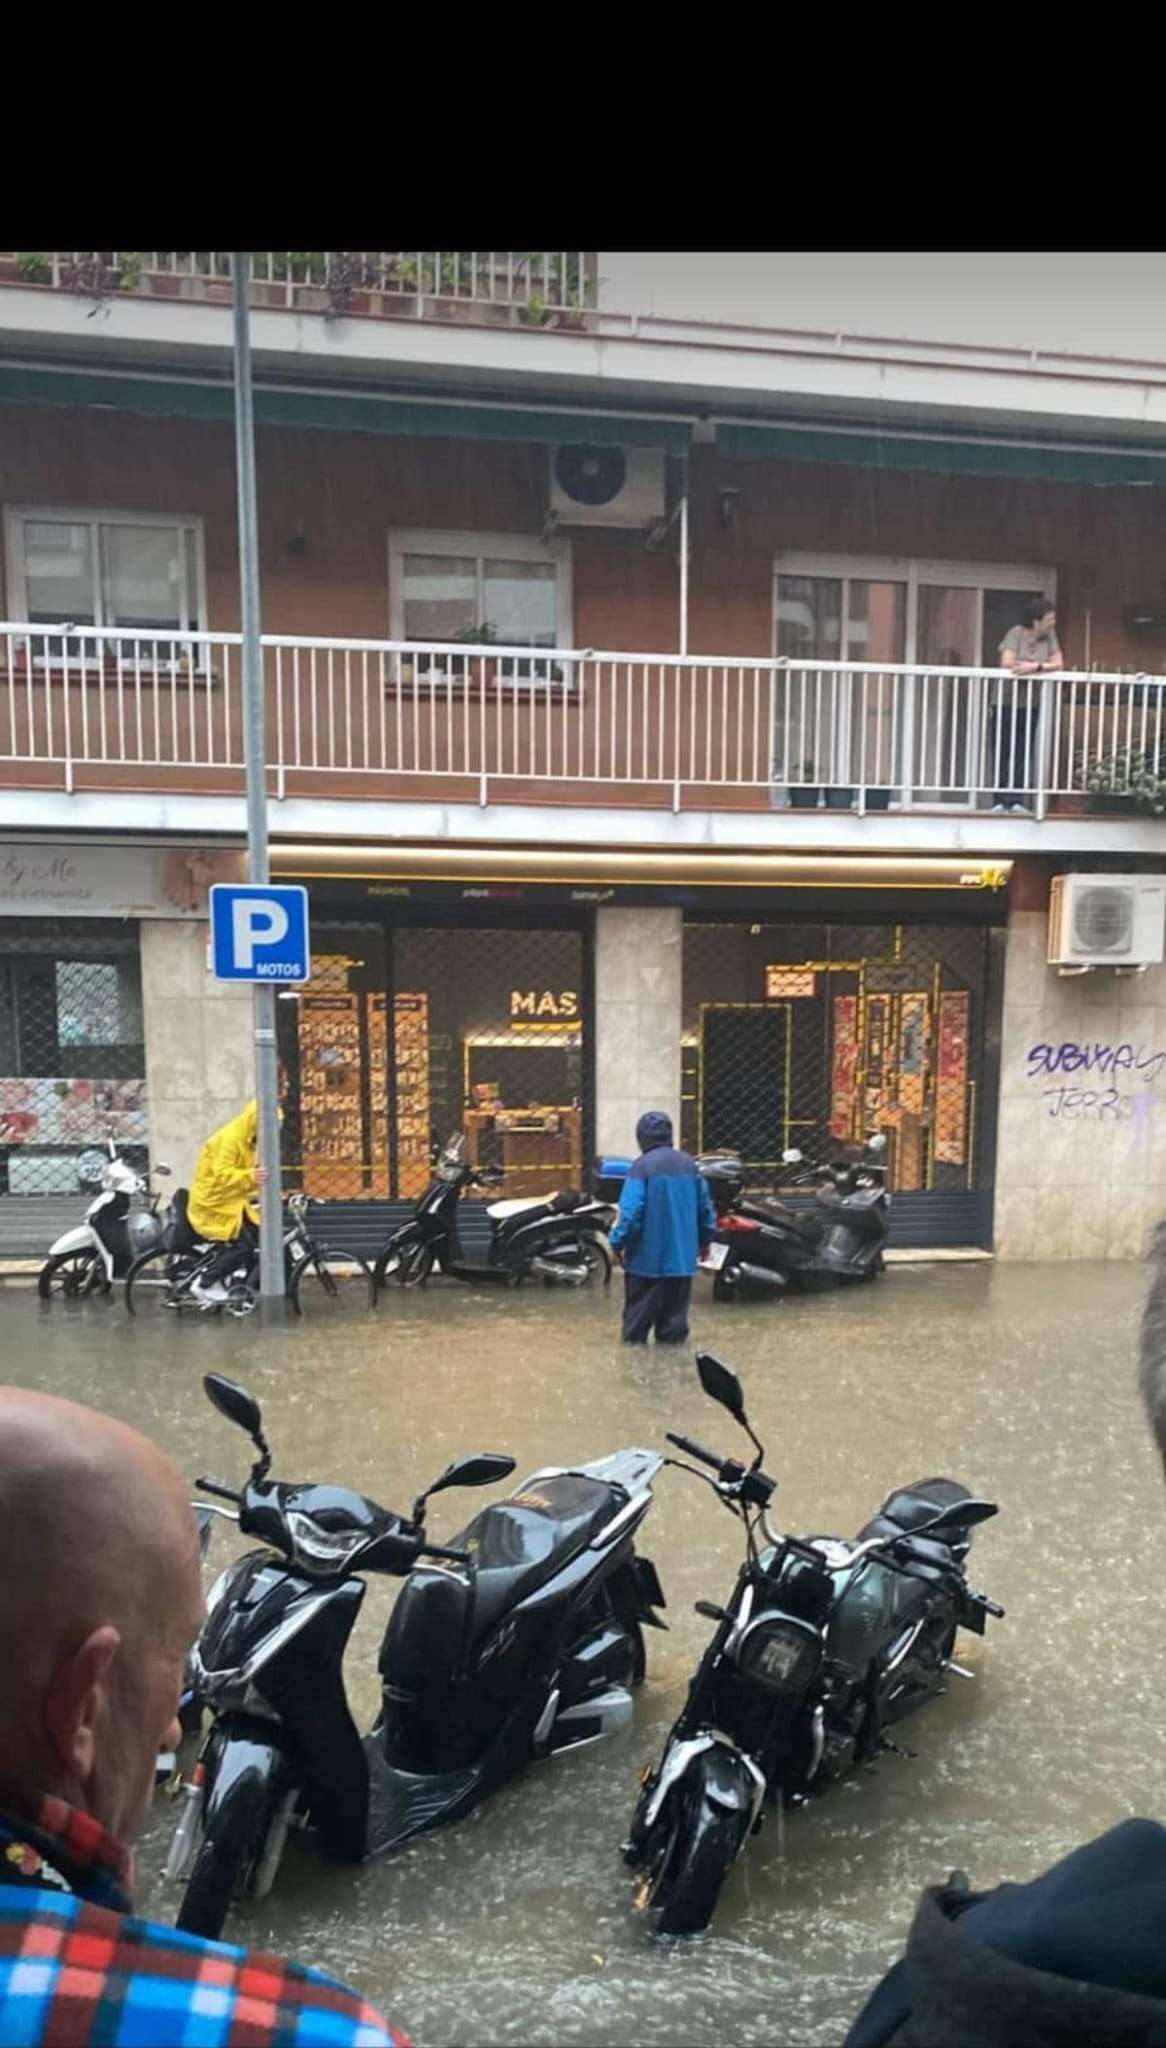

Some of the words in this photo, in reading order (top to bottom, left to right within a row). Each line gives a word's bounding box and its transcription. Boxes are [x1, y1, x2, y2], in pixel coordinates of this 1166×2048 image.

[232, 898, 289, 969] P
[256, 963, 301, 976] MOTOS
[510, 990, 578, 1016] MAS
